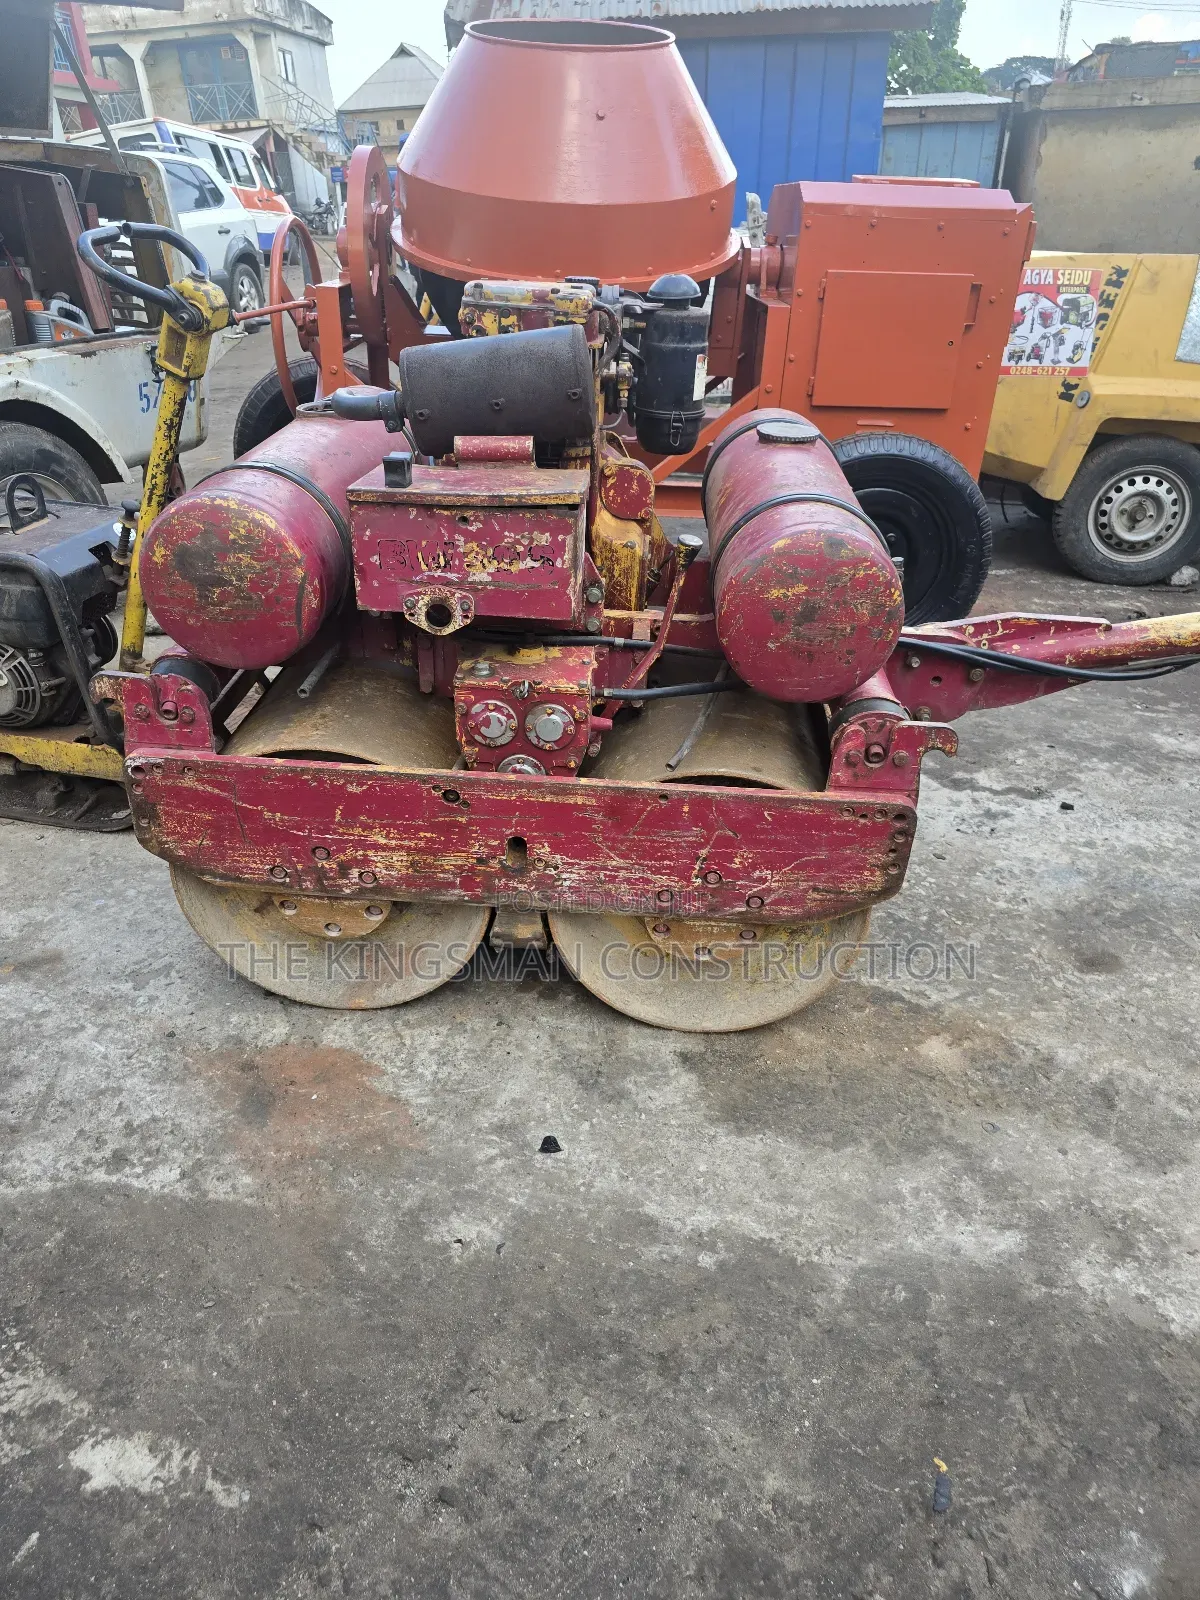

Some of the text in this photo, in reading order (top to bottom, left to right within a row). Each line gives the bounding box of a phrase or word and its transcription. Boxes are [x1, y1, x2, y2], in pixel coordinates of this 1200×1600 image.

[1023, 269, 1092, 286] AGYA SEIDU
[1053, 366, 1071, 376] 257
